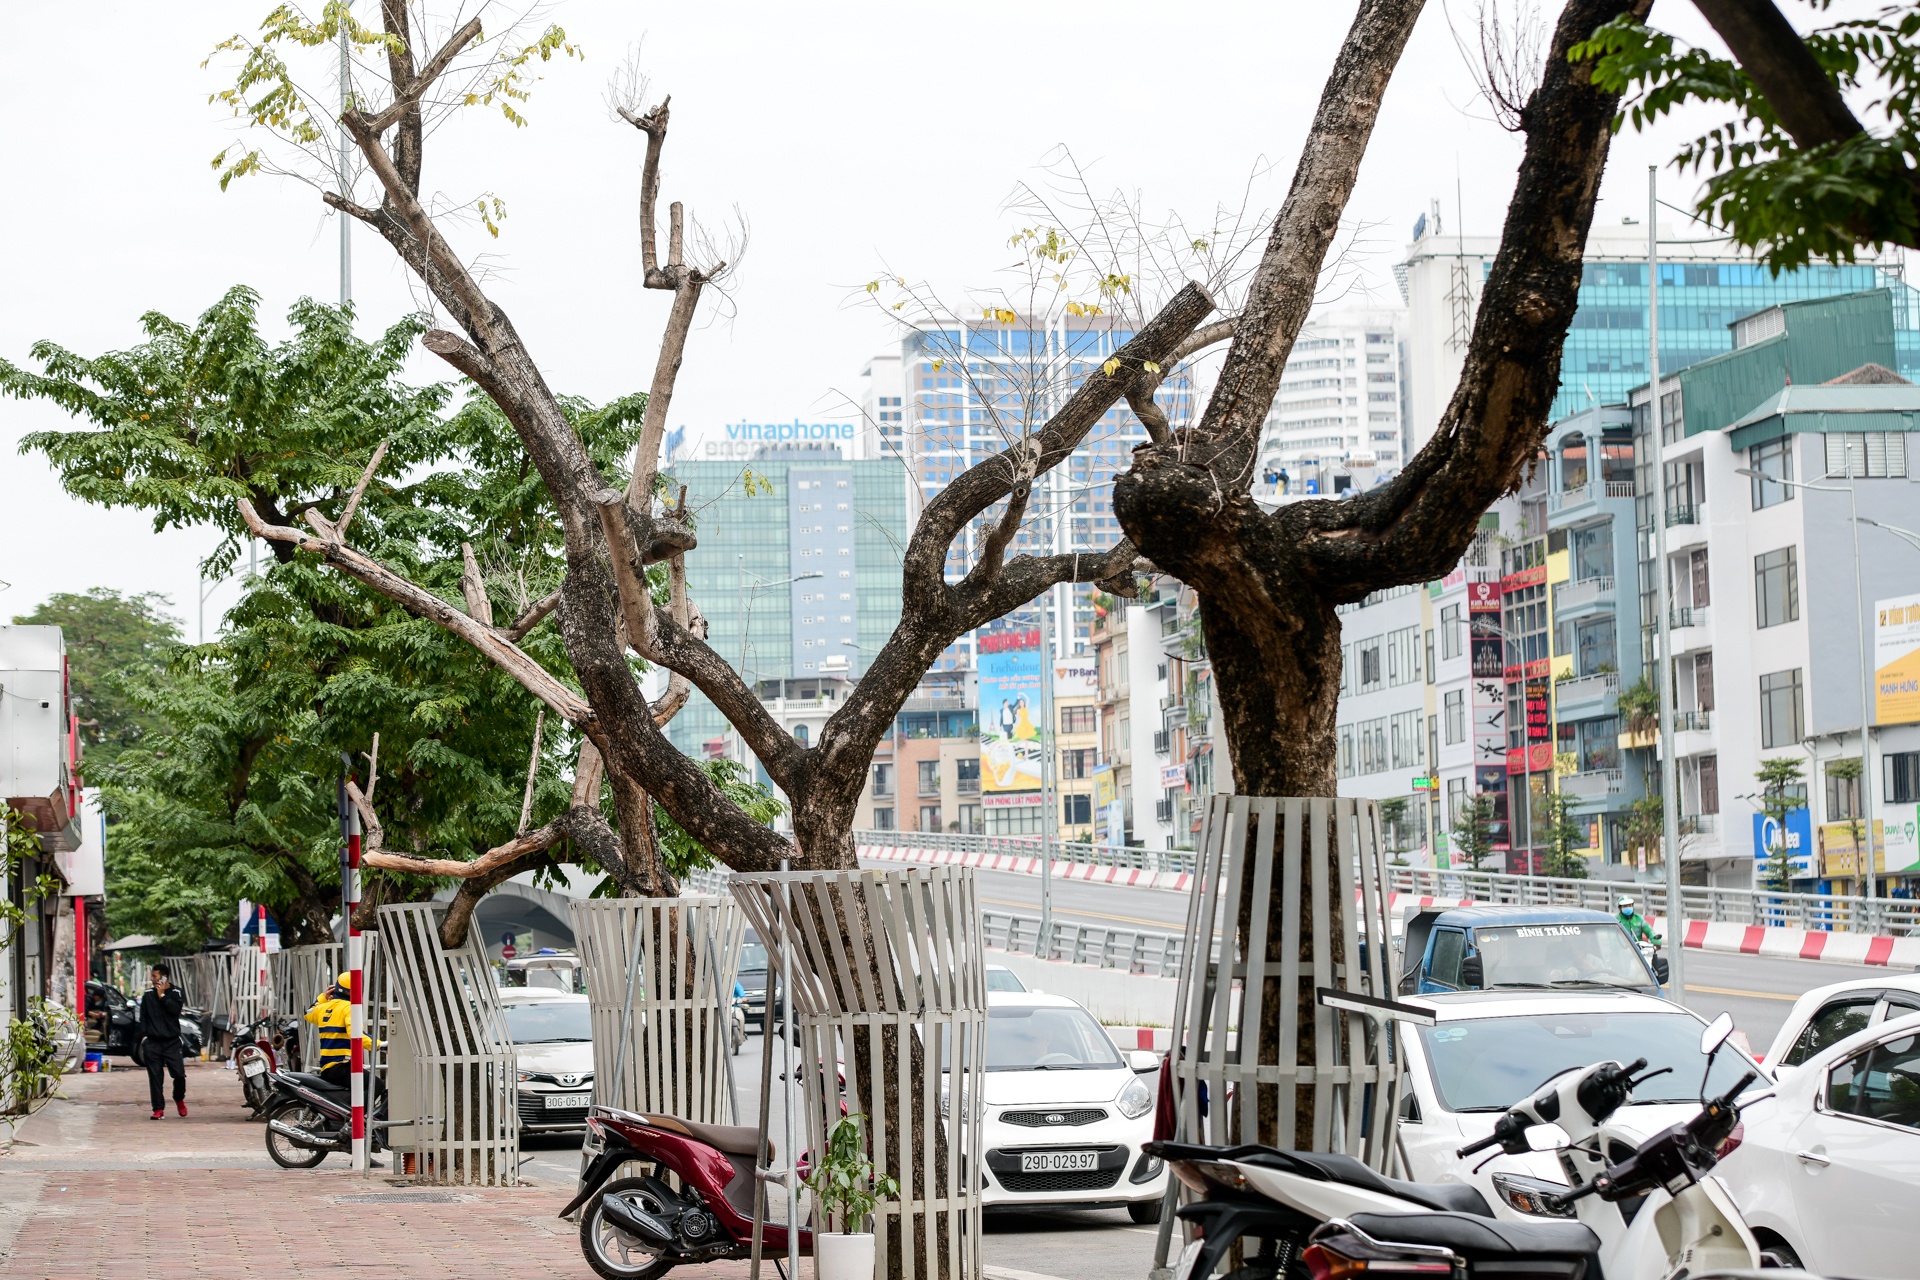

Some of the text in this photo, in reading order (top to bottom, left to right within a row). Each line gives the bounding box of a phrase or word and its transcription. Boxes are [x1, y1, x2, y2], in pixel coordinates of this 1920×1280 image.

[725, 419, 854, 442] vinaphone
[1068, 669, 1078, 677] TP
[1880, 683, 1898, 698] MẠNH
[1516, 925, 1581, 938] BÌNH TRÁNG
[1048, 1114, 1062, 1122] KIA
[1024, 1154, 1095, 1170] 29D-029.97
